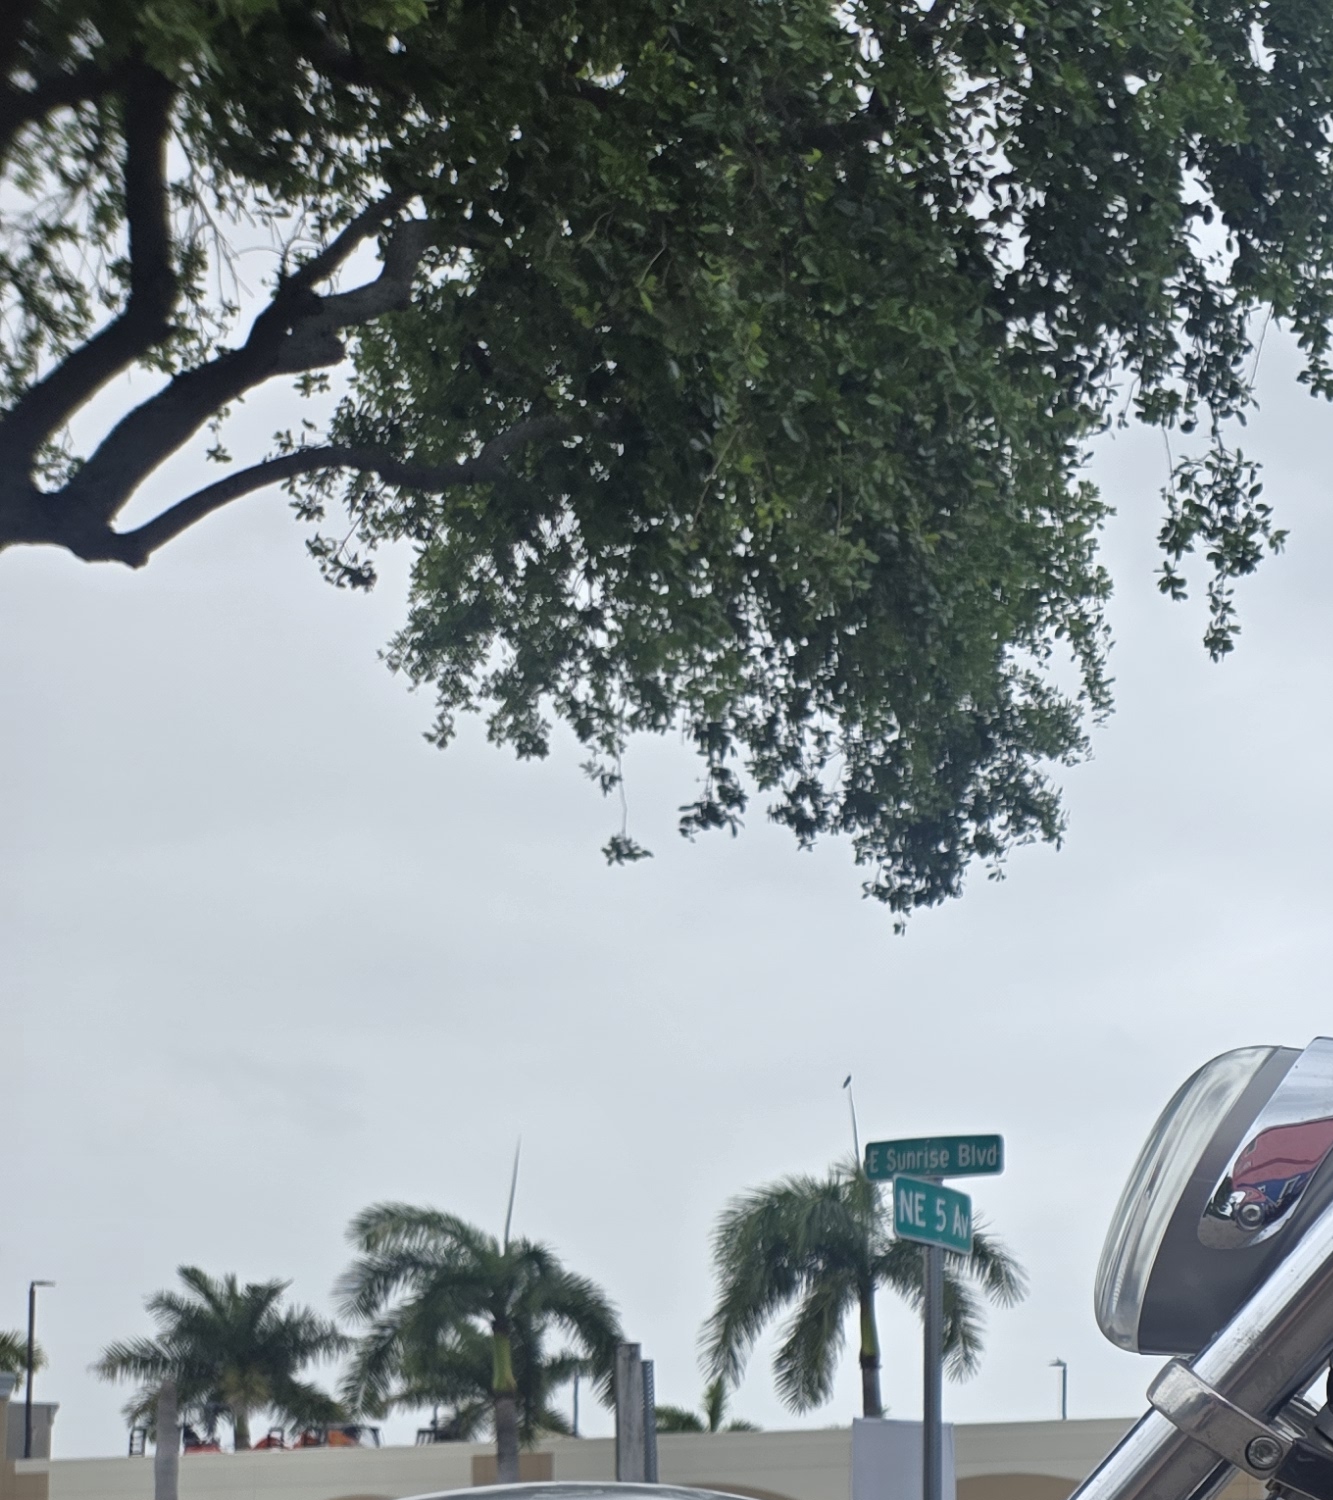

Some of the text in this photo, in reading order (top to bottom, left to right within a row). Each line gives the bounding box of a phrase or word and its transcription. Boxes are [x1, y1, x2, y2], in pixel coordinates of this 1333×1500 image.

[869, 1143, 997, 1174] E Sunrise Blvd
[899, 1188, 969, 1239] NE 5 Av
